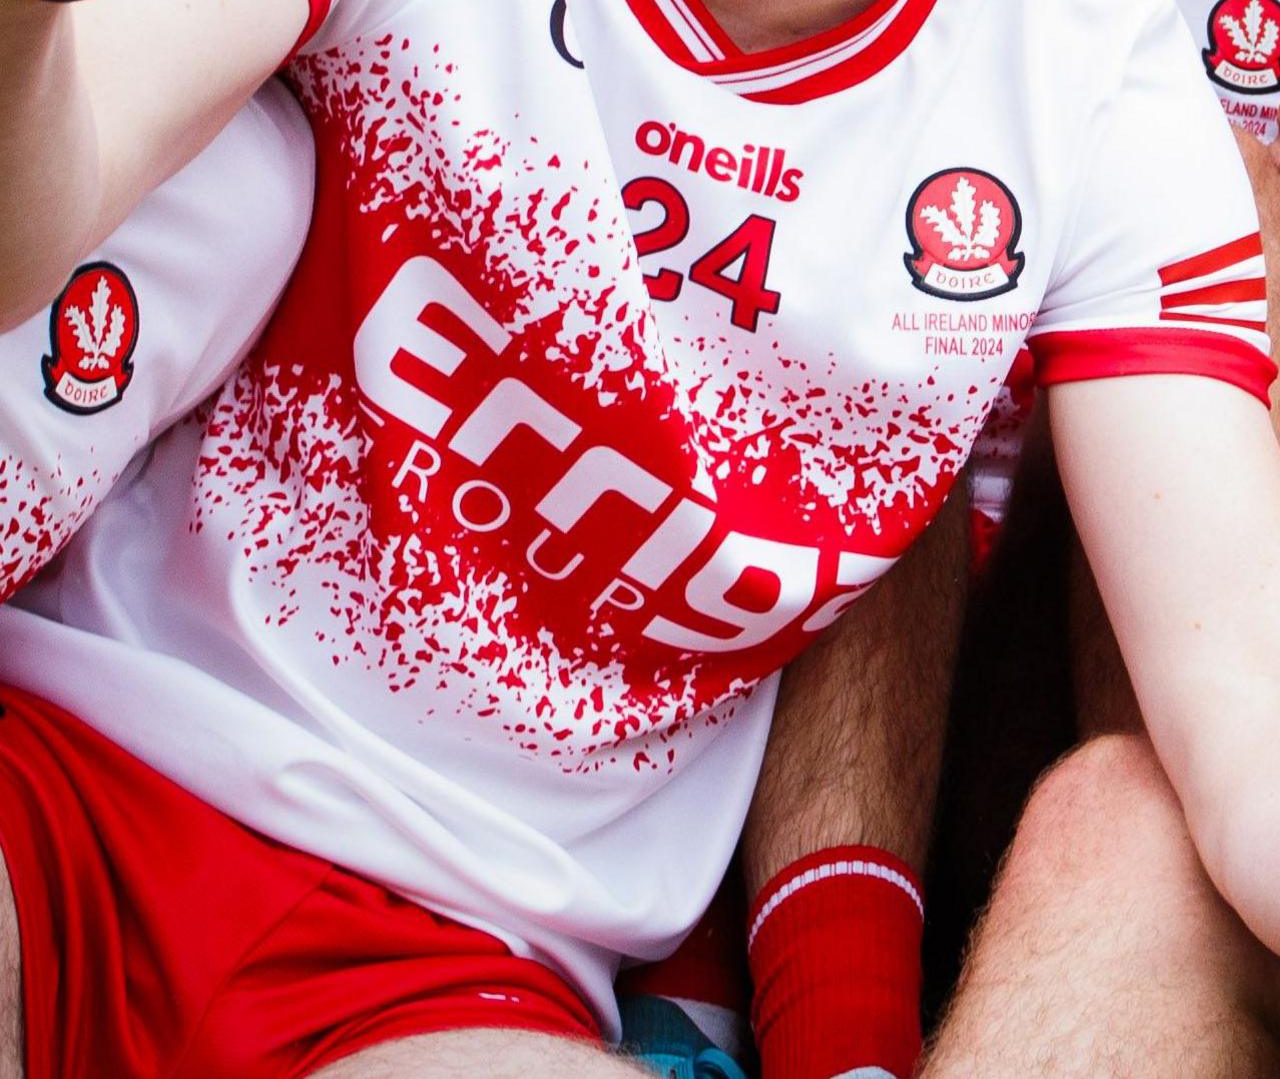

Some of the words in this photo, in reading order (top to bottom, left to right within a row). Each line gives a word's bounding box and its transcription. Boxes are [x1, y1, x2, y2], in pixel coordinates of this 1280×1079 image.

[634, 120, 804, 203] o'neills
[620, 176, 781, 333] 24
[892, 313, 920, 331] ALL
[924, 313, 988, 332] IRELAND
[925, 337, 967, 355] FINAL
[972, 338, 1004, 356] 2024
[392, 438, 646, 616] ROUP
